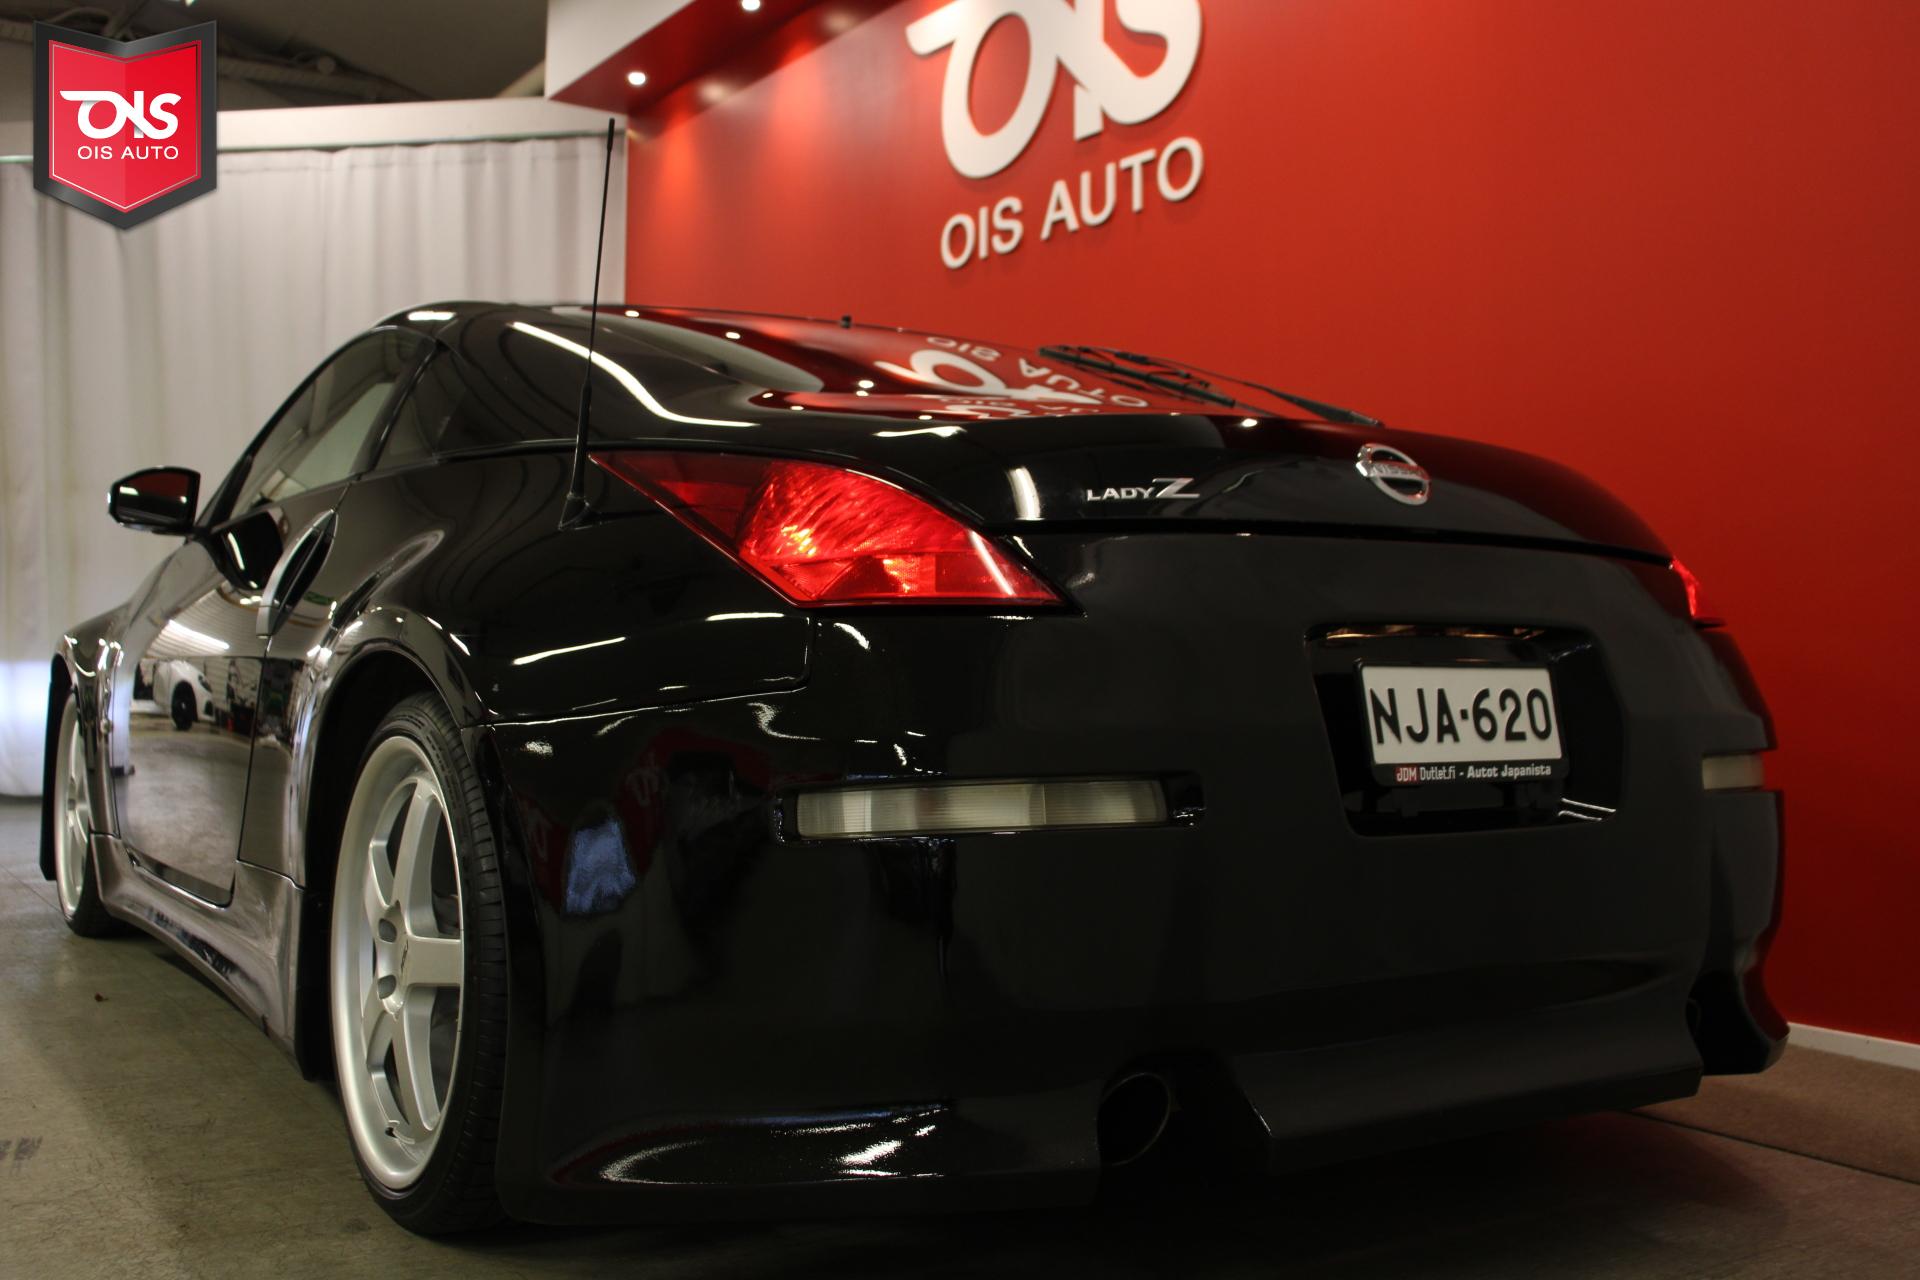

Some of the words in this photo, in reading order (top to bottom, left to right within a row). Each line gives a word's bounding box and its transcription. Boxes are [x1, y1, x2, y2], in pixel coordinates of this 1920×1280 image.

[940, 196, 1023, 269] OIS
[1040, 136, 1204, 241] AUTO
[1087, 487, 1154, 501] LADY
[1369, 688, 1551, 744] NJA-620
[1396, 767, 1417, 782] JDM
[1467, 765, 1498, 779] Autot
[1501, 763, 1552, 780] Japanista
